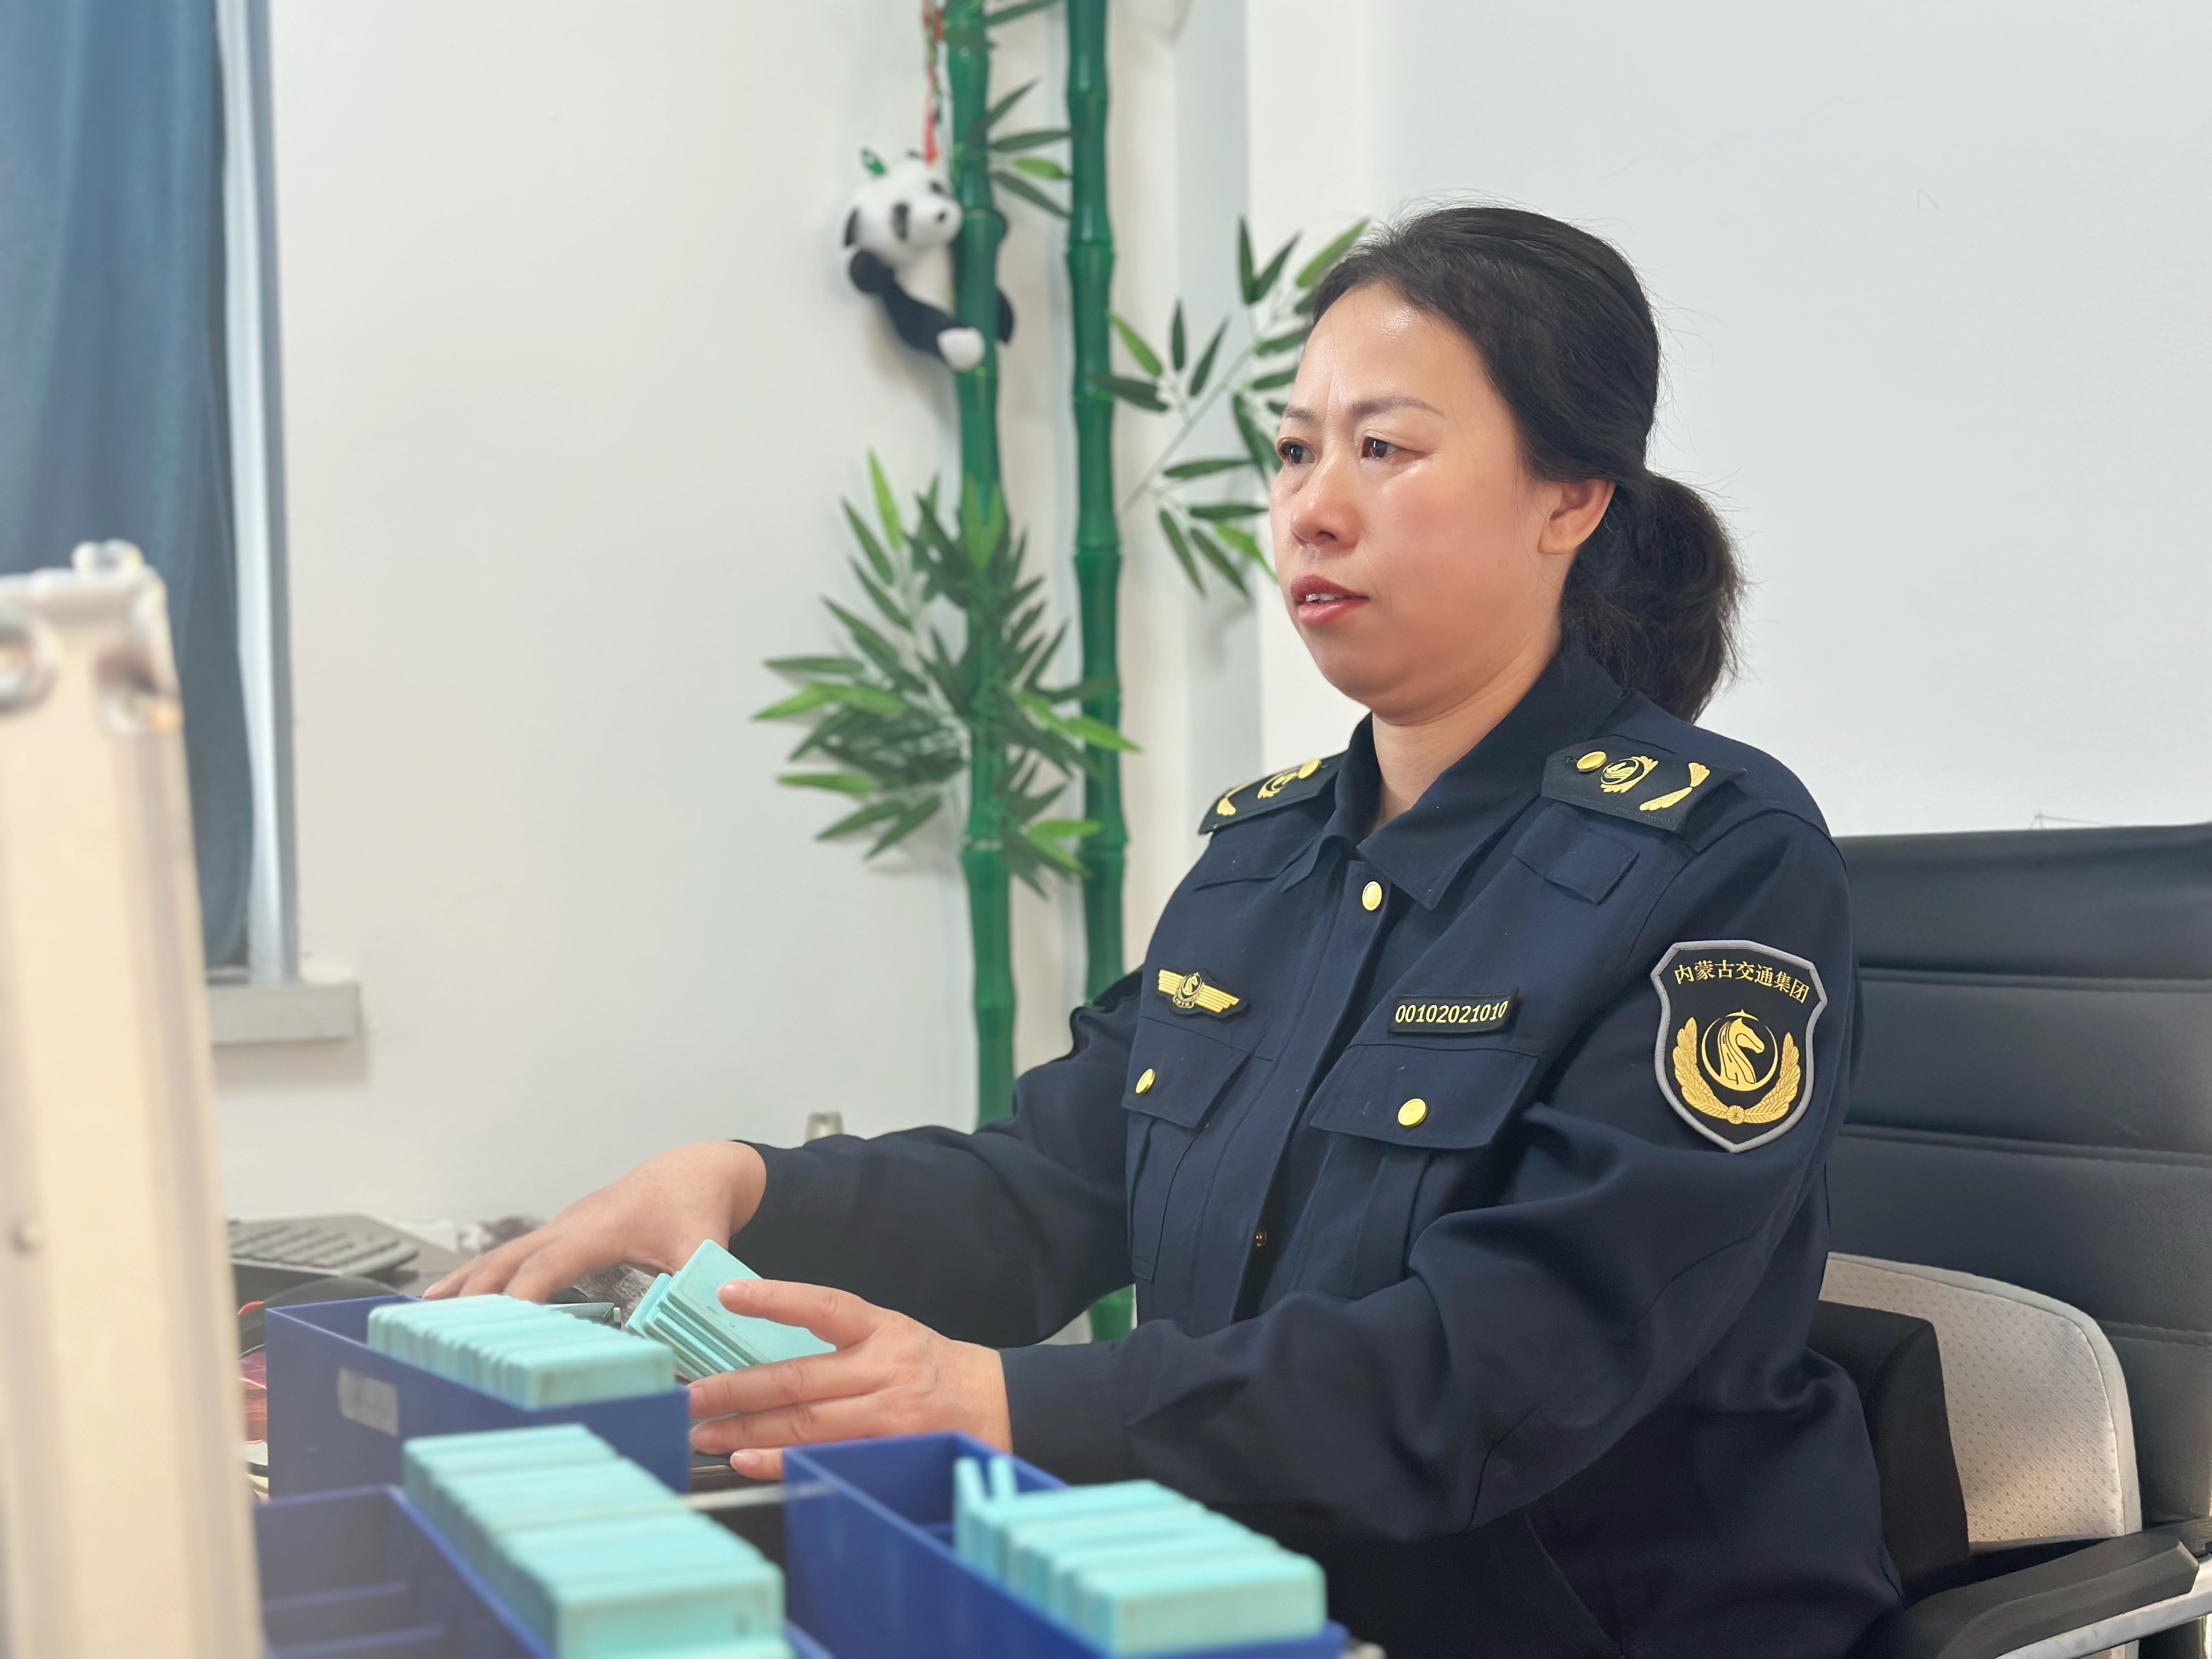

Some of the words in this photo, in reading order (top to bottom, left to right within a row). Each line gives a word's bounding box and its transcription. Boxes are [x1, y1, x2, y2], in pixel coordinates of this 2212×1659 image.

[1674, 960, 1809, 1003] 内蒙古交通集团
[1395, 1001, 1508, 1023] 00102021010
